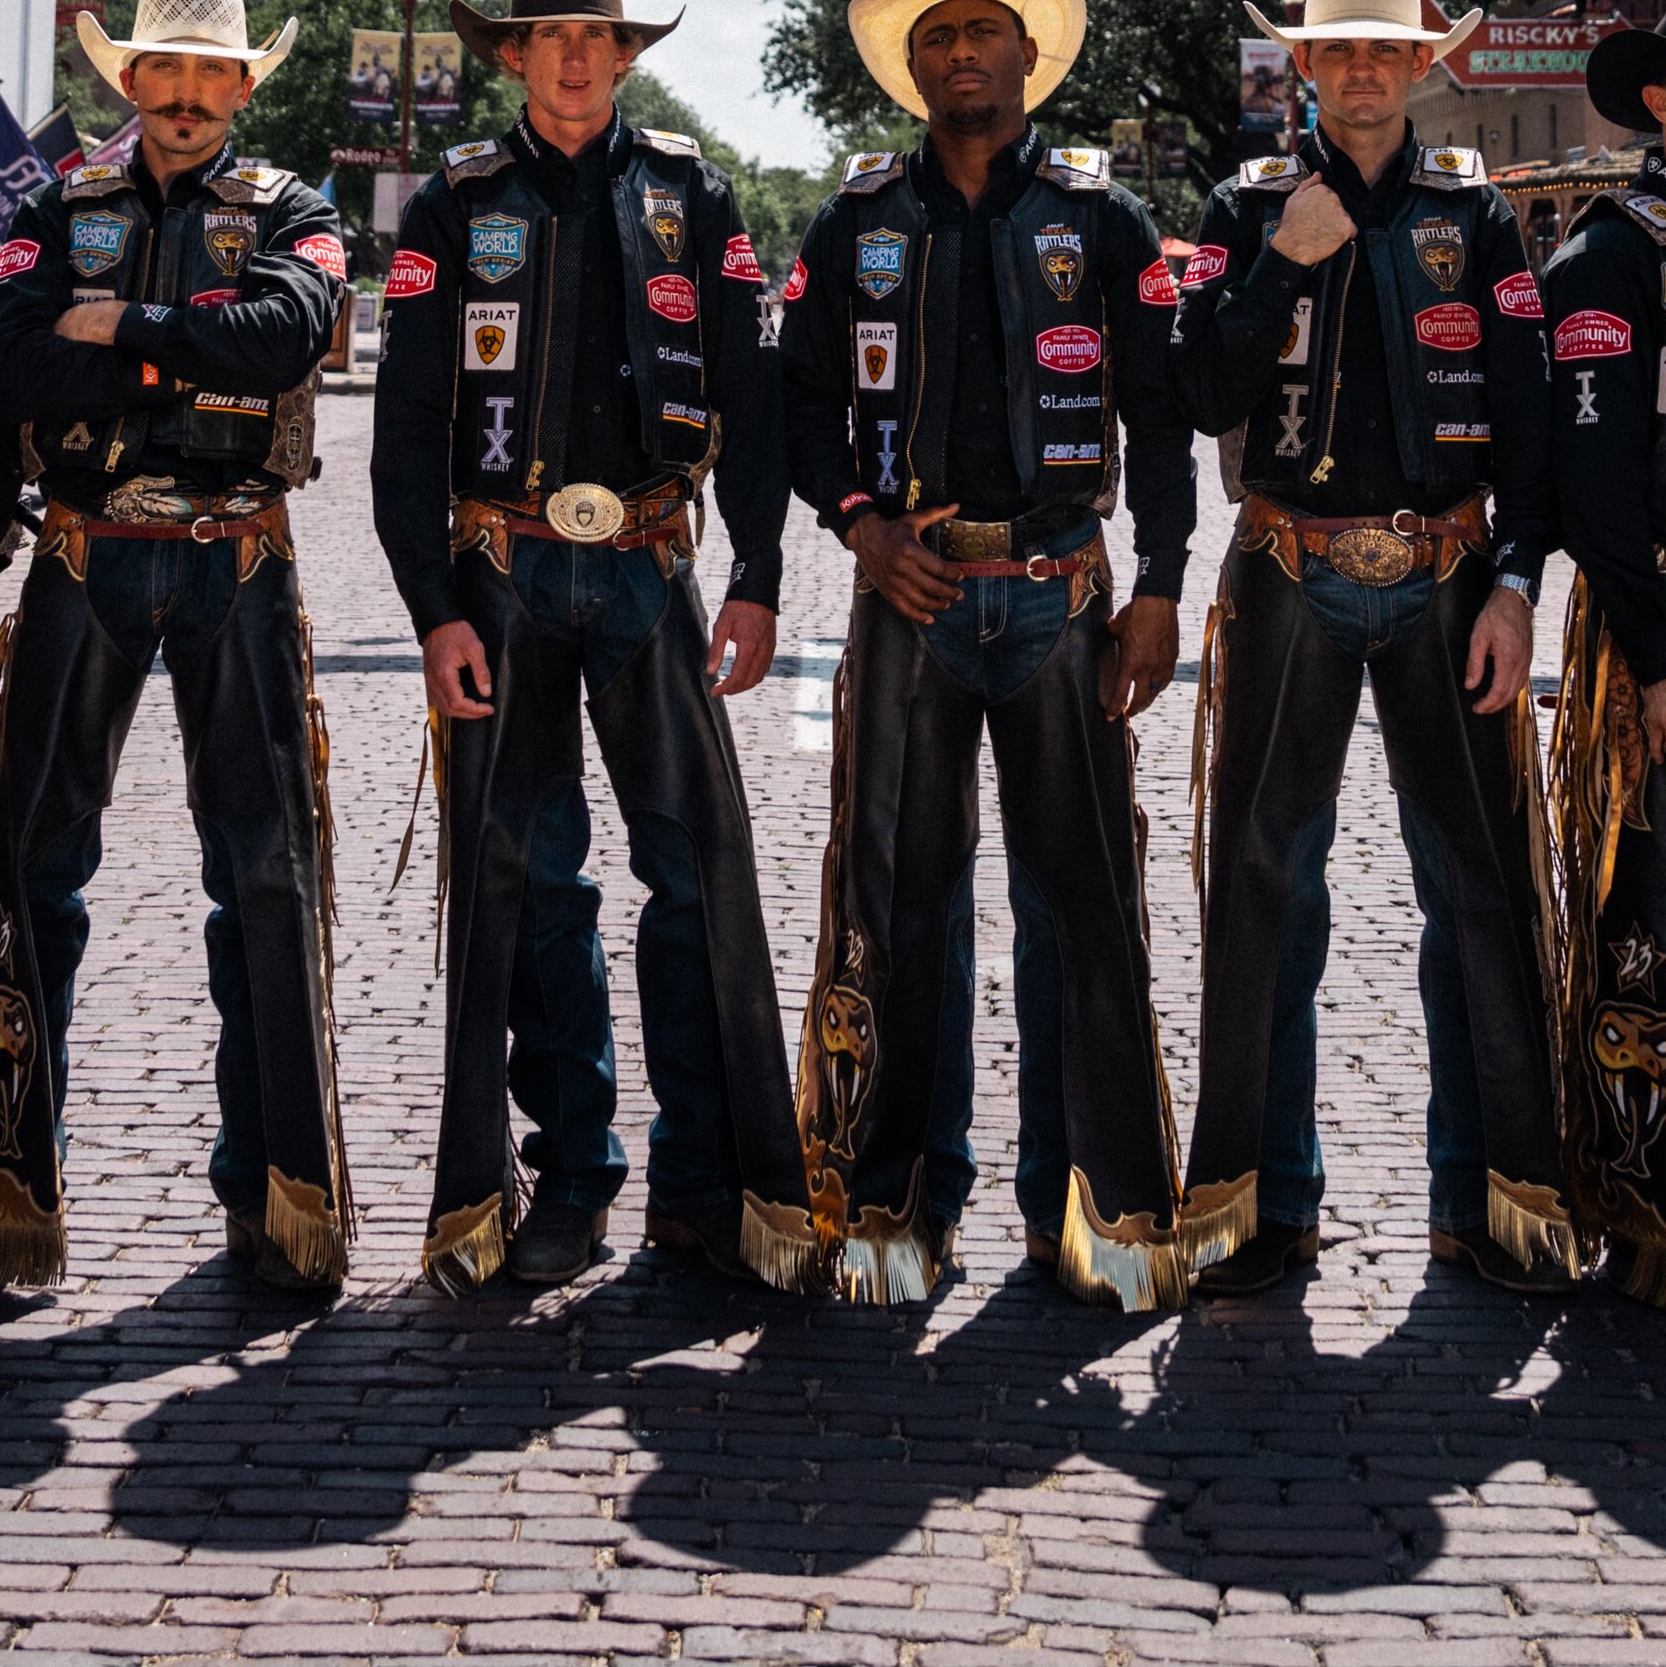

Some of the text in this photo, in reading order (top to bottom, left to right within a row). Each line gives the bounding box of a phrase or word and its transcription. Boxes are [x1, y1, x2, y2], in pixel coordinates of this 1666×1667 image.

[1489, 26, 1600, 44] RISCKY'S
[1469, 50, 1590, 73] STEAKHOU
[346, 147, 381, 163] Rodeo
[204, 213, 257, 231] RATTLERS
[74, 225, 121, 241] CAMPING
[74, 234, 118, 249] WORLD
[471, 230, 518, 245] CAMPING
[1412, 226, 1462, 246] RATTLERS
[473, 238, 518, 254] WORLD
[860, 246, 900, 259] CAMPING
[1034, 234, 1082, 255] RATTLERS
[861, 256, 899, 269] WORLD
[651, 286, 694, 308] Community
[469, 309, 516, 321] ARIAT
[859, 329, 896, 341] ARIAT
[1420, 318, 1478, 337] Community
[1557, 325, 1627, 352] Community
[664, 346, 702, 367] Land.com
[1039, 340, 1098, 359] Community
[1438, 369, 1485, 384] Land.com
[195, 392, 269, 411] can-am
[1051, 394, 1100, 409] Land.com
[662, 402, 707, 424] can-am
[1435, 422, 1491, 437] can-am
[1044, 443, 1101, 460] can-am
[1620, 937, 1655, 978] 23
